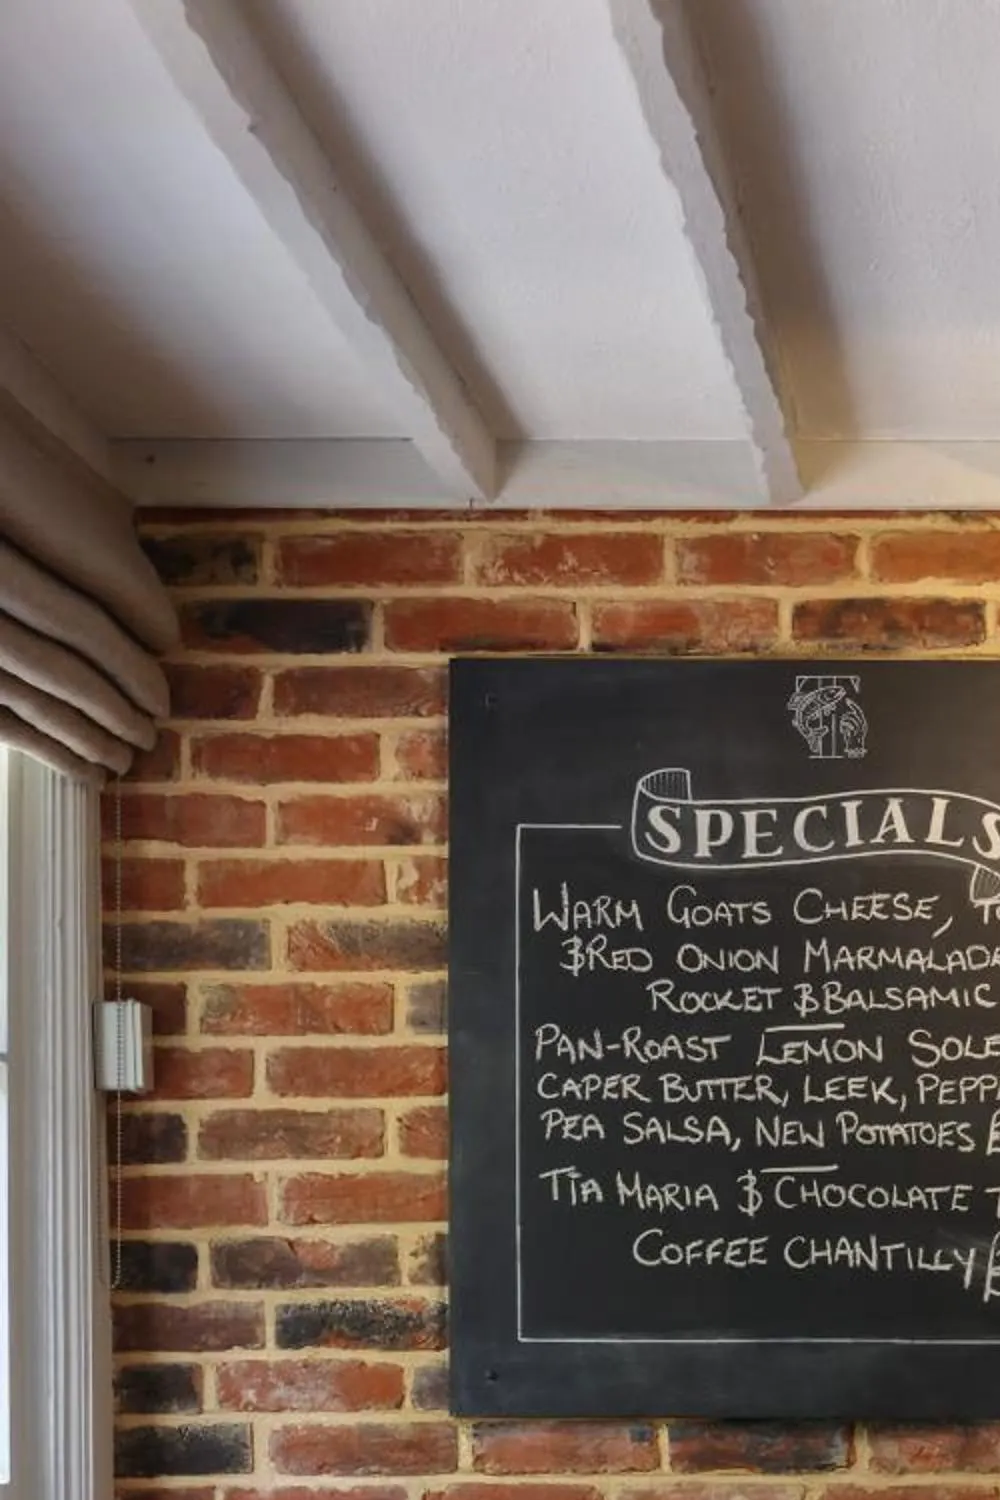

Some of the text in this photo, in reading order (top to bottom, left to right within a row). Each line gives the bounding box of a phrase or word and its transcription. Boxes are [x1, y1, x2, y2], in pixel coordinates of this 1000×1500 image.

[532, 881, 645, 932] WARM
[666, 884, 772, 929] GOATS
[793, 887, 954, 941] CHEESE,
[585, 933, 653, 973] RED
[675, 943, 780, 975] ONION
[645, 978, 783, 1015] ROCKET
[821, 980, 998, 1015] BALSAMIC
[534, 1022, 732, 1065] PAN-ROAST
[755, 1032, 884, 1066] LEMON
[537, 1071, 652, 1104] CAPER
[657, 1072, 790, 1108] BUTTER,
[803, 1074, 907, 1115] LEEK,
[539, 1107, 606, 1142] PEA
[622, 1111, 742, 1153] SALSA,
[755, 1114, 825, 1149] NEW
[835, 1110, 976, 1152] POTATOES
[538, 1165, 604, 1206] TIA
[615, 1171, 720, 1214] MARIA
[774, 1175, 974, 1212] CHOCOLATE
[632, 1227, 769, 1268] COFFEE
[783, 1234, 977, 1290] CHANTILLY
